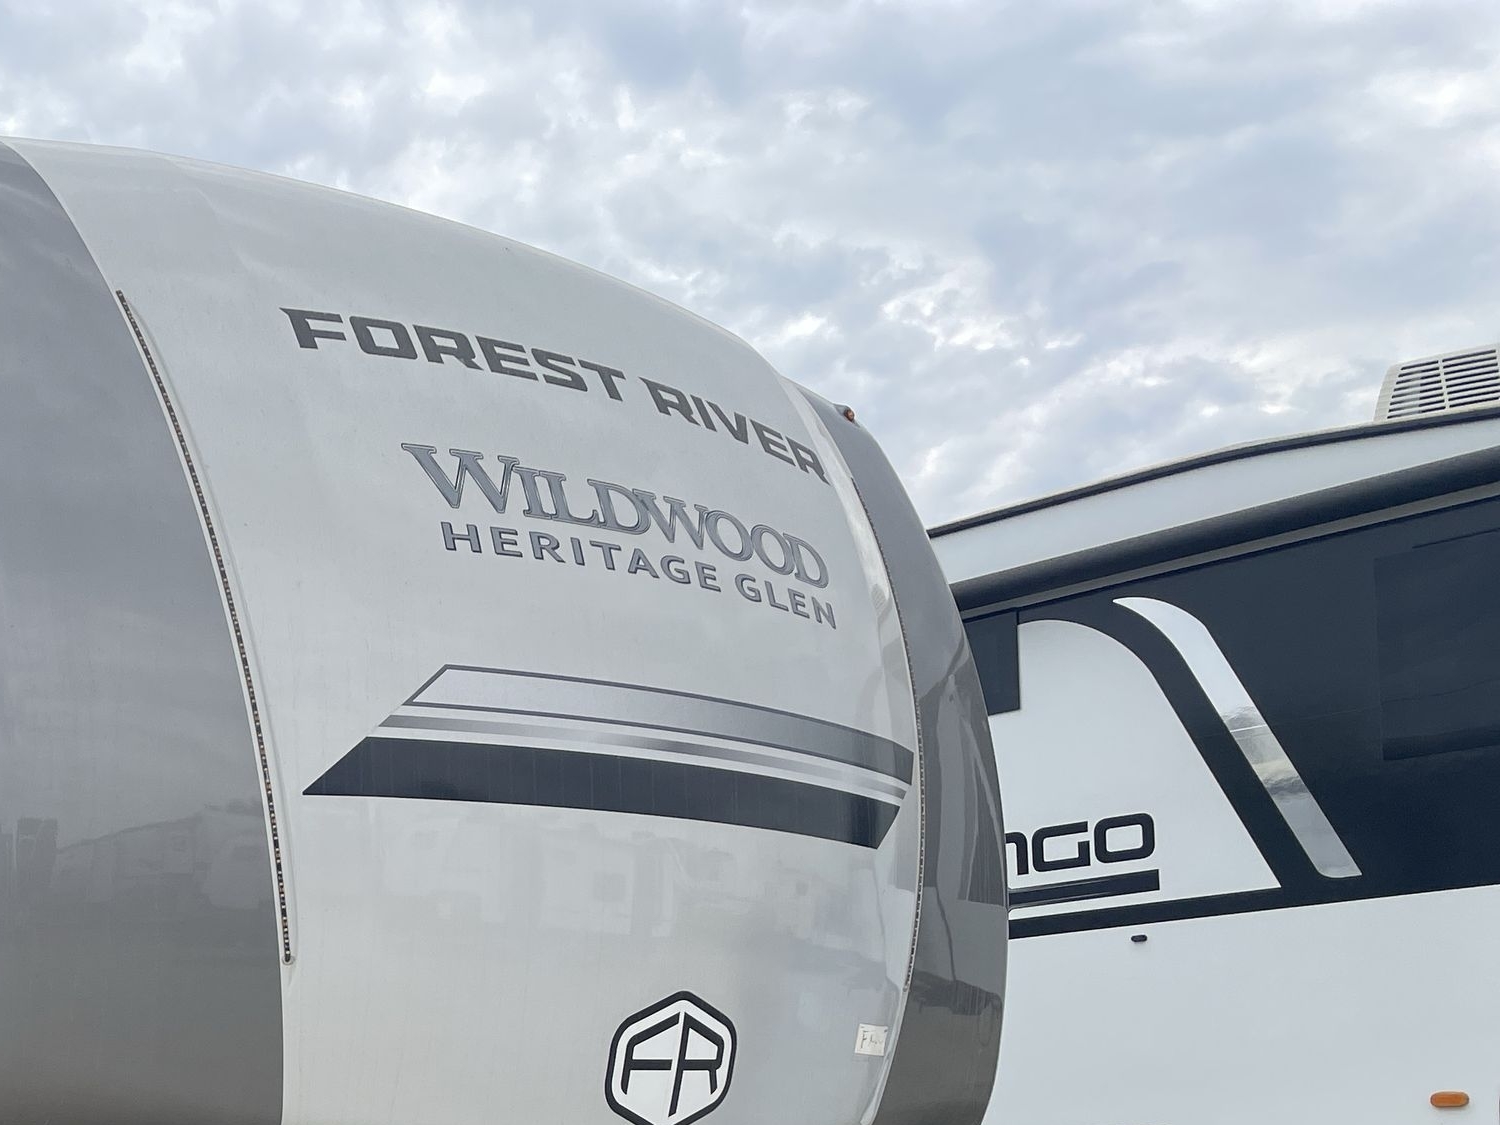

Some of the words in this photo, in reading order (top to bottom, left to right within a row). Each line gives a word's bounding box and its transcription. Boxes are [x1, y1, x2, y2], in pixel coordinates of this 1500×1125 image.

[279, 307, 626, 402] FOREST
[639, 377, 832, 484] RIVER
[401, 442, 829, 589] WILDWOOD
[440, 521, 722, 592] HERITAGE
[734, 575, 837, 630] GLEN
